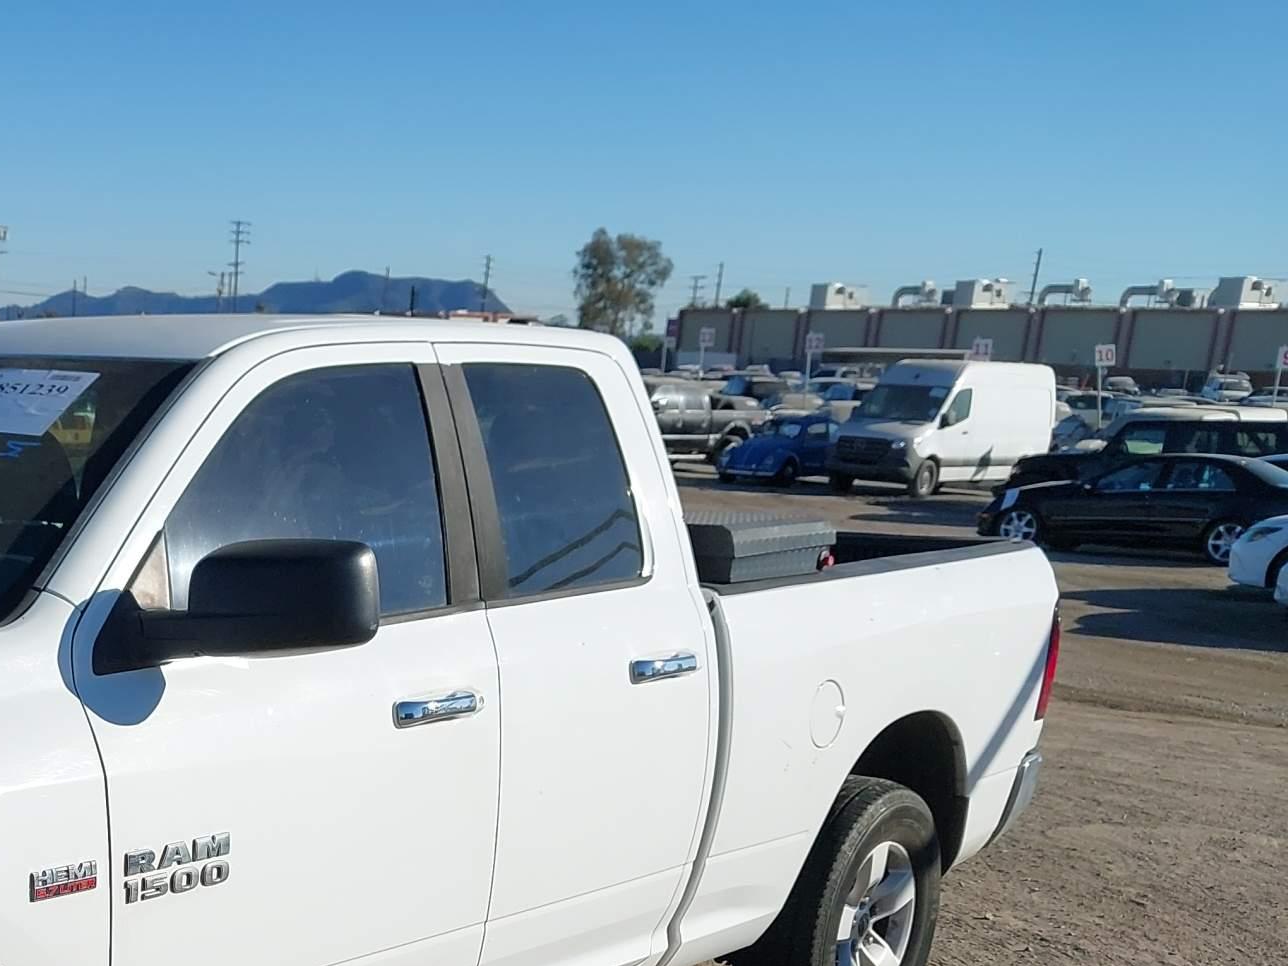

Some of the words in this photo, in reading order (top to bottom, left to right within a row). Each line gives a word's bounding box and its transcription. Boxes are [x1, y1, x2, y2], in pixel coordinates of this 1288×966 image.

[1096, 348, 1113, 362] 10
[124, 831, 231, 878] RAM
[29, 859, 97, 890] HEMI
[36, 884, 58, 900] 5.7
[59, 877, 96, 895] LITER
[123, 859, 230, 905] 1500
